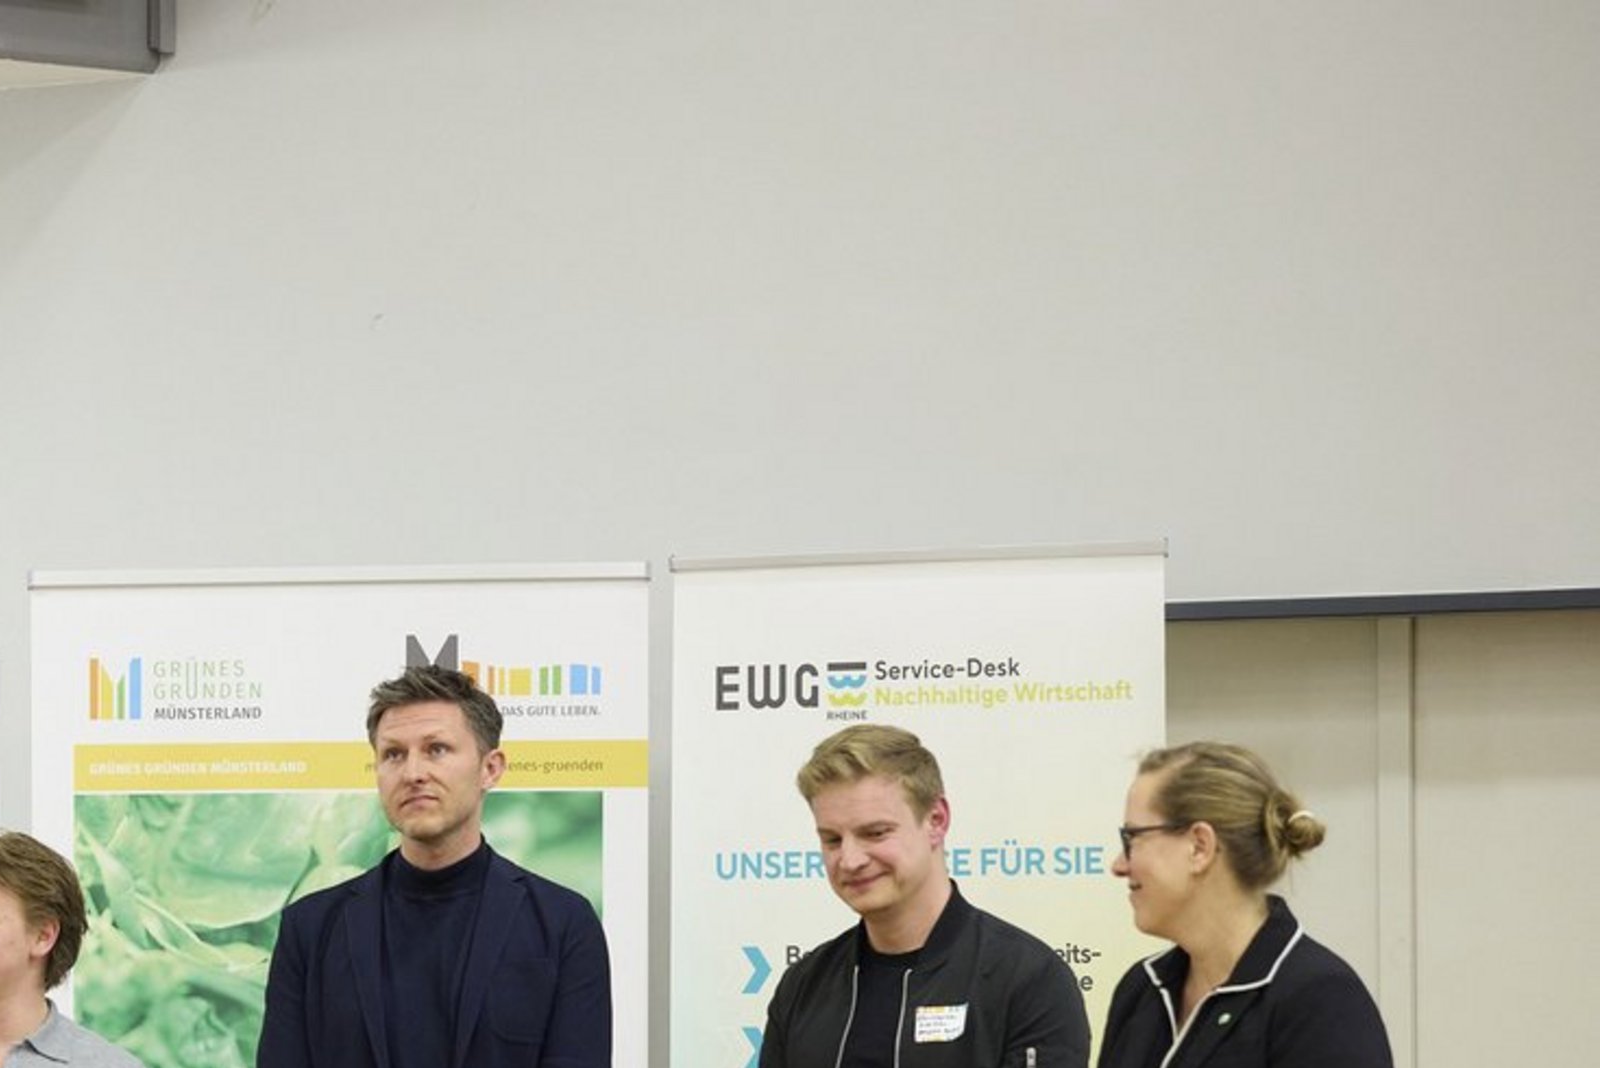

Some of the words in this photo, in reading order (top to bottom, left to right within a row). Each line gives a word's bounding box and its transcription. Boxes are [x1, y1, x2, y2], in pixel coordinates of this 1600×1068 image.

[152, 655, 246, 679] GRÜNES
[874, 658, 1021, 681] Service-Desk
[715, 662, 819, 711] EWG
[874, 684, 1008, 708] Nachhaltige
[1013, 680, 1133, 702] Wirtschaft
[153, 703, 263, 720] MÜNSTERLAND
[501, 704, 524, 716] DAS
[527, 704, 556, 716] GUTE
[826, 710, 868, 721] RHEINE
[508, 757, 604, 773] enes-gruenden
[980, 840, 1045, 875] FÜR
[1054, 846, 1104, 874] SIE
